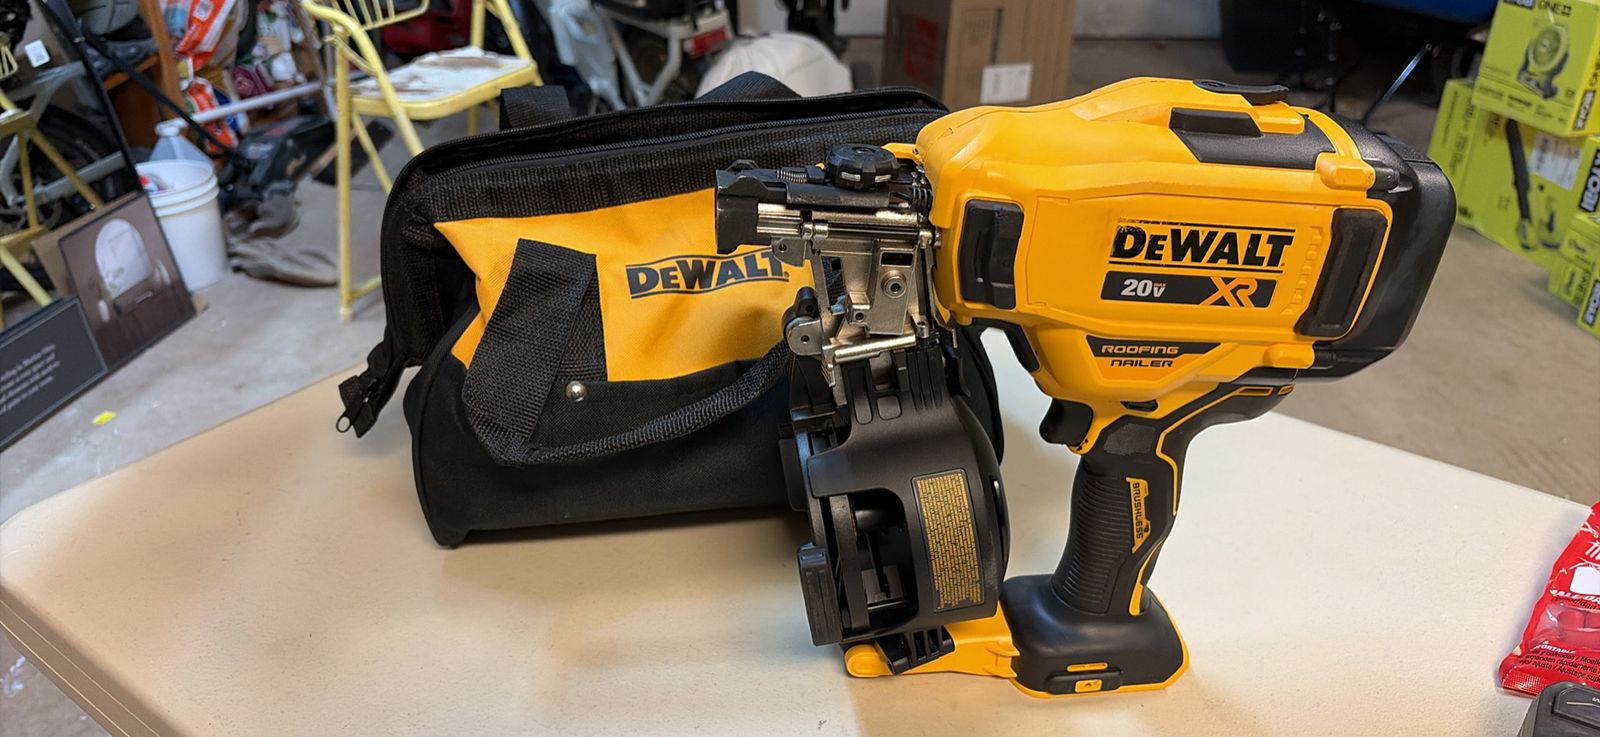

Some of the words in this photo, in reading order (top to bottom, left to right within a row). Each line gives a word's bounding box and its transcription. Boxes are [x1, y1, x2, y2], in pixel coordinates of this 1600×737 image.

[1110, 225, 1294, 267] DEWALT
[1200, 277, 1257, 308] XR
[1101, 345, 1179, 354] ROOFING
[1132, 482, 1144, 539] BRUSHLESS
